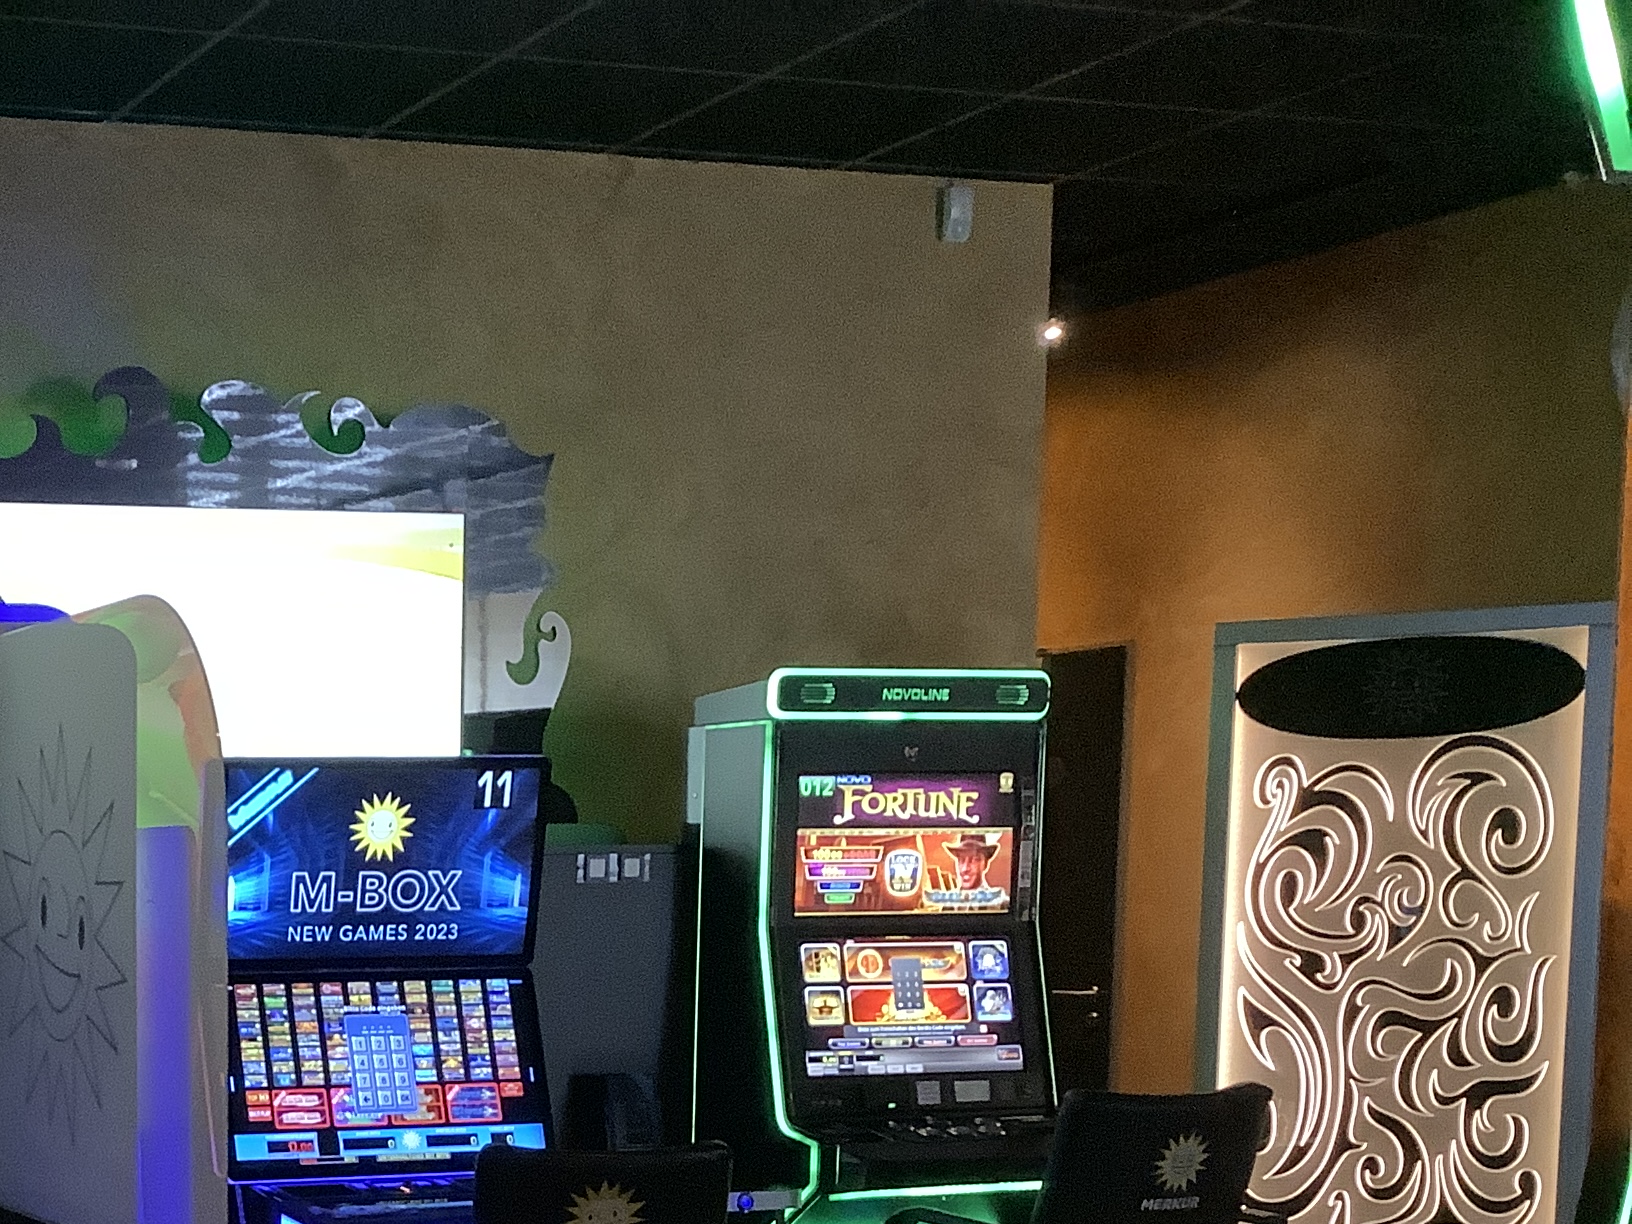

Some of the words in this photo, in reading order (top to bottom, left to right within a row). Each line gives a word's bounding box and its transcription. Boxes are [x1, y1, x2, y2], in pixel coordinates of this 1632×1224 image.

[882, 688, 950, 701] NOVOLINE
[478, 770, 513, 808] 11
[799, 778, 834, 797] 012
[833, 784, 980, 825] FORTUNE
[290, 870, 463, 913] M-BOX
[287, 925, 334, 942] NEW
[339, 924, 408, 942] GAMES
[414, 923, 459, 941] 2023
[387, 1139, 395, 1149] 0
[470, 1136, 477, 1146] 0
[506, 1134, 514, 1145] 0
[1140, 1196, 1200, 1211] MERKUR
